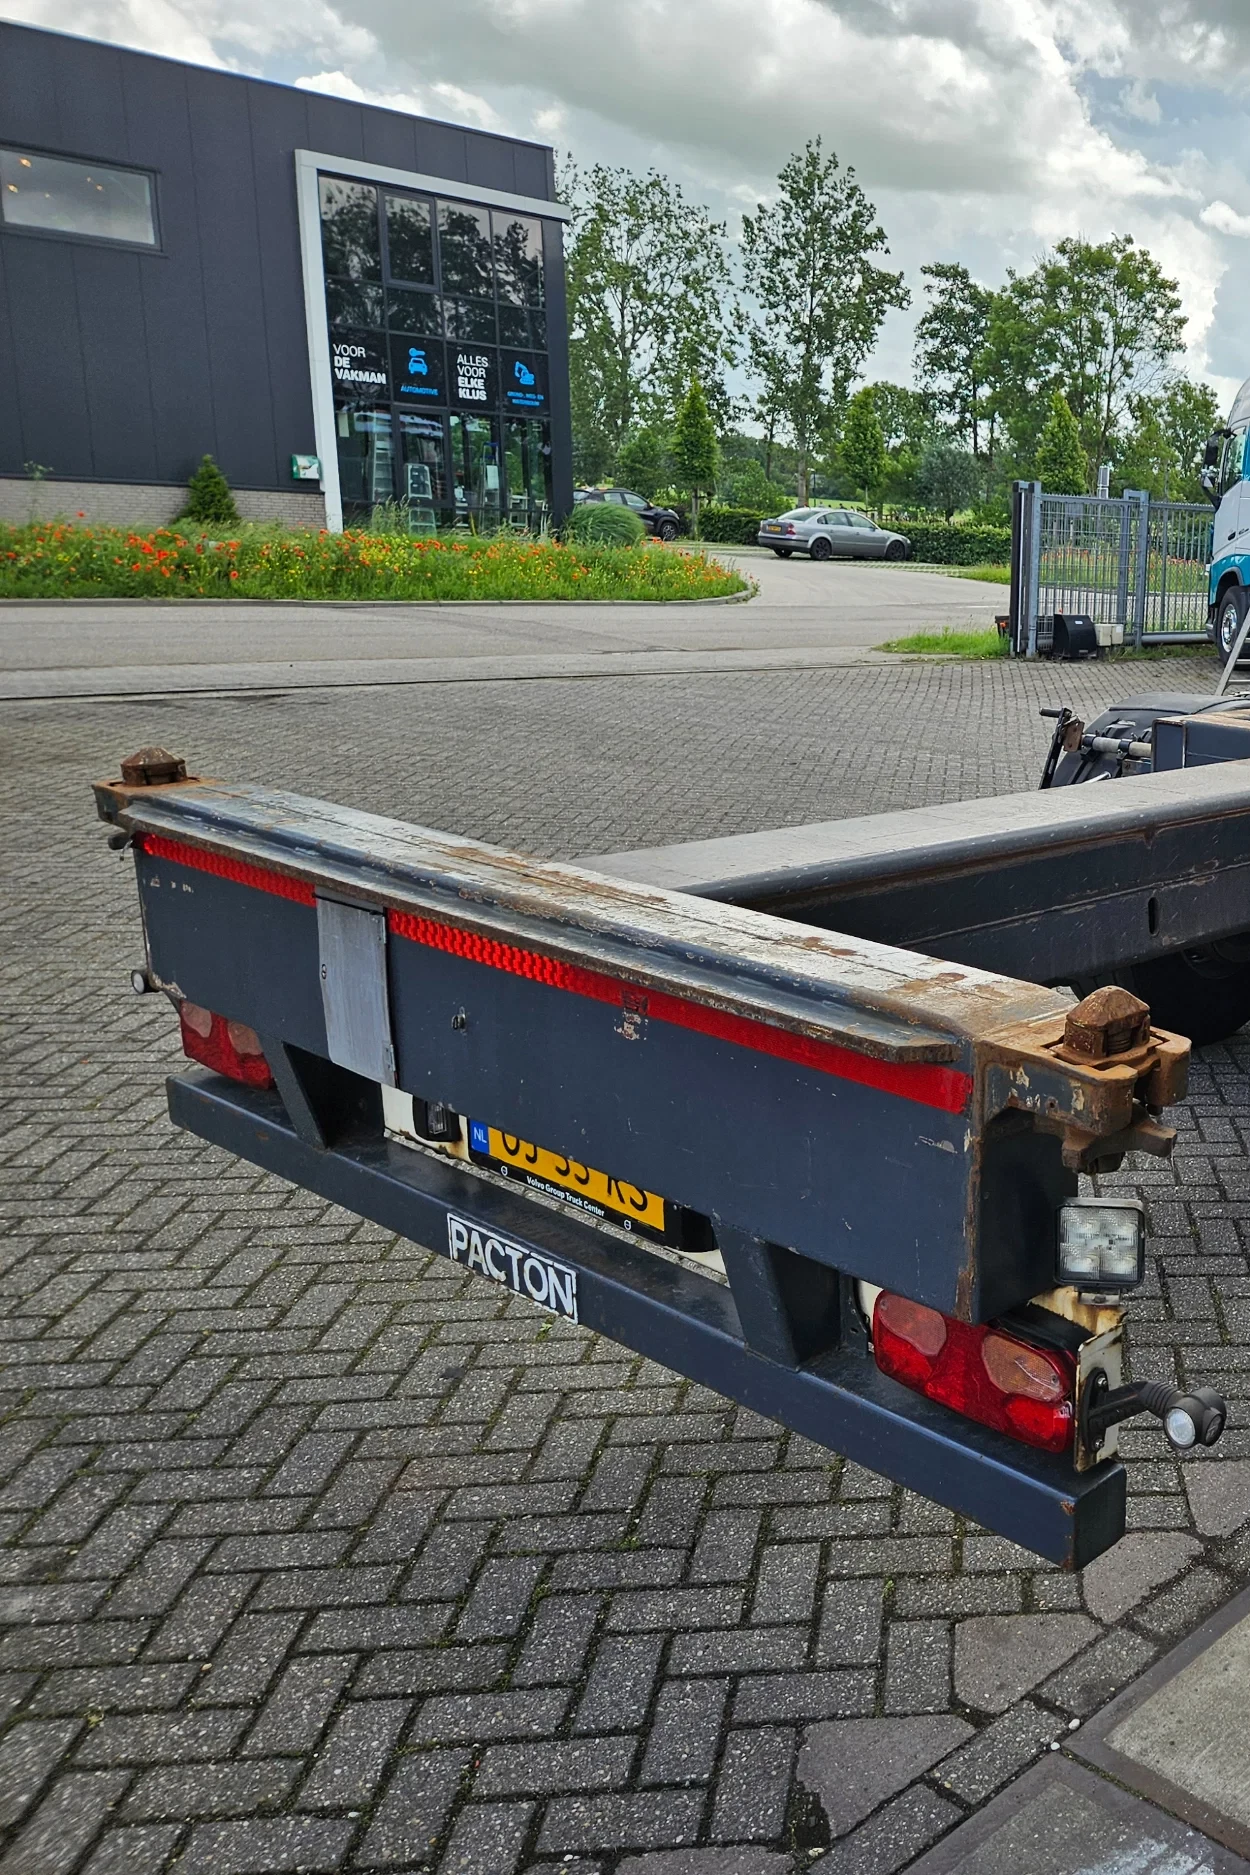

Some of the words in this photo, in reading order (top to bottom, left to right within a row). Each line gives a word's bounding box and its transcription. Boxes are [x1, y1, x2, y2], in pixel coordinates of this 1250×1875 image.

[333, 344, 366, 358] VOOR
[334, 356, 350, 368] DE
[457, 354, 489, 368] ALLES
[334, 368, 386, 385] VAKMAN
[457, 365, 486, 378] VOOR
[401, 385, 438, 396] AUTOMOTIVE
[458, 377, 485, 390] ELKE
[458, 388, 487, 401] KLUS
[473, 1126, 488, 1144] NL
[527, 1176, 545, 1190] Volvo
[545, 1183, 565, 1200] Group
[565, 1191, 583, 1207] Truck
[584, 1202, 605, 1217] Center
[450, 1220, 574, 1314] PACTON
